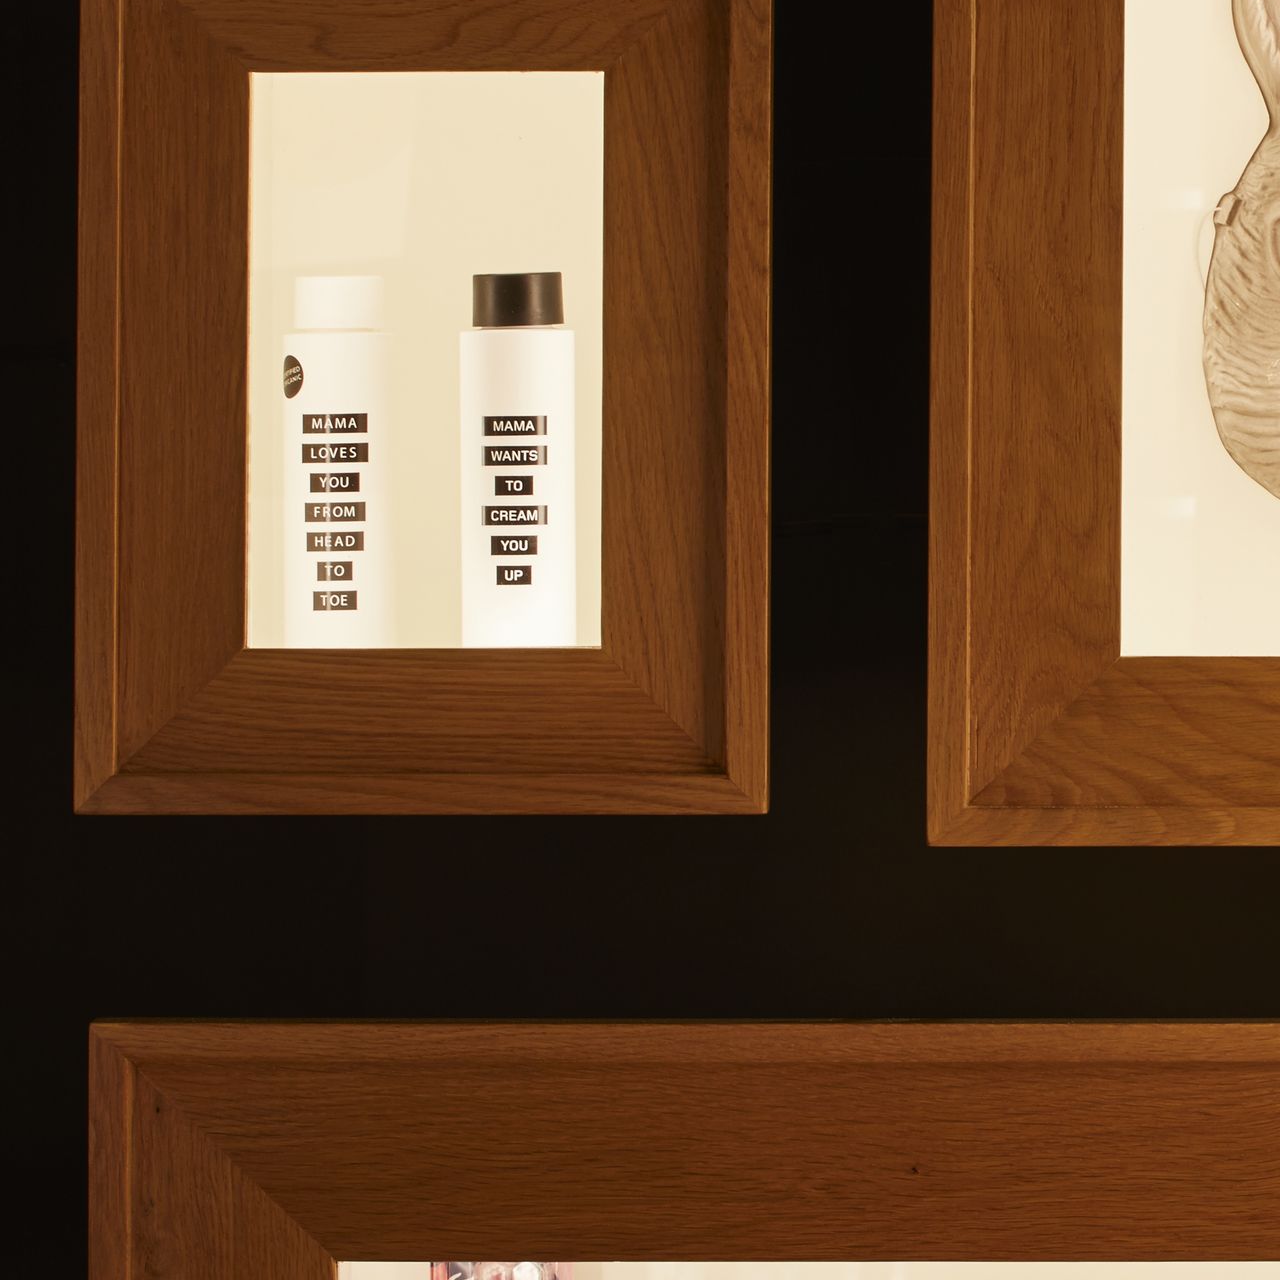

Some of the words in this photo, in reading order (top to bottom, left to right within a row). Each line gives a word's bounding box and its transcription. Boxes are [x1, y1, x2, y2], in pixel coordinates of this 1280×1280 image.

[311, 417, 357, 429] MAMA
[493, 420, 535, 432] MAMA
[310, 446, 357, 459] LOVES
[490, 450, 539, 462] WANTS
[319, 476, 350, 488] YOU
[505, 480, 523, 492] TO
[313, 505, 356, 518] FROM
[490, 510, 539, 522] CREAM
[314, 535, 356, 548] HEAD
[500, 539, 528, 552] YOU
[324, 564, 345, 577] TO
[504, 570, 524, 581] UP
[320, 594, 348, 607] TOE
